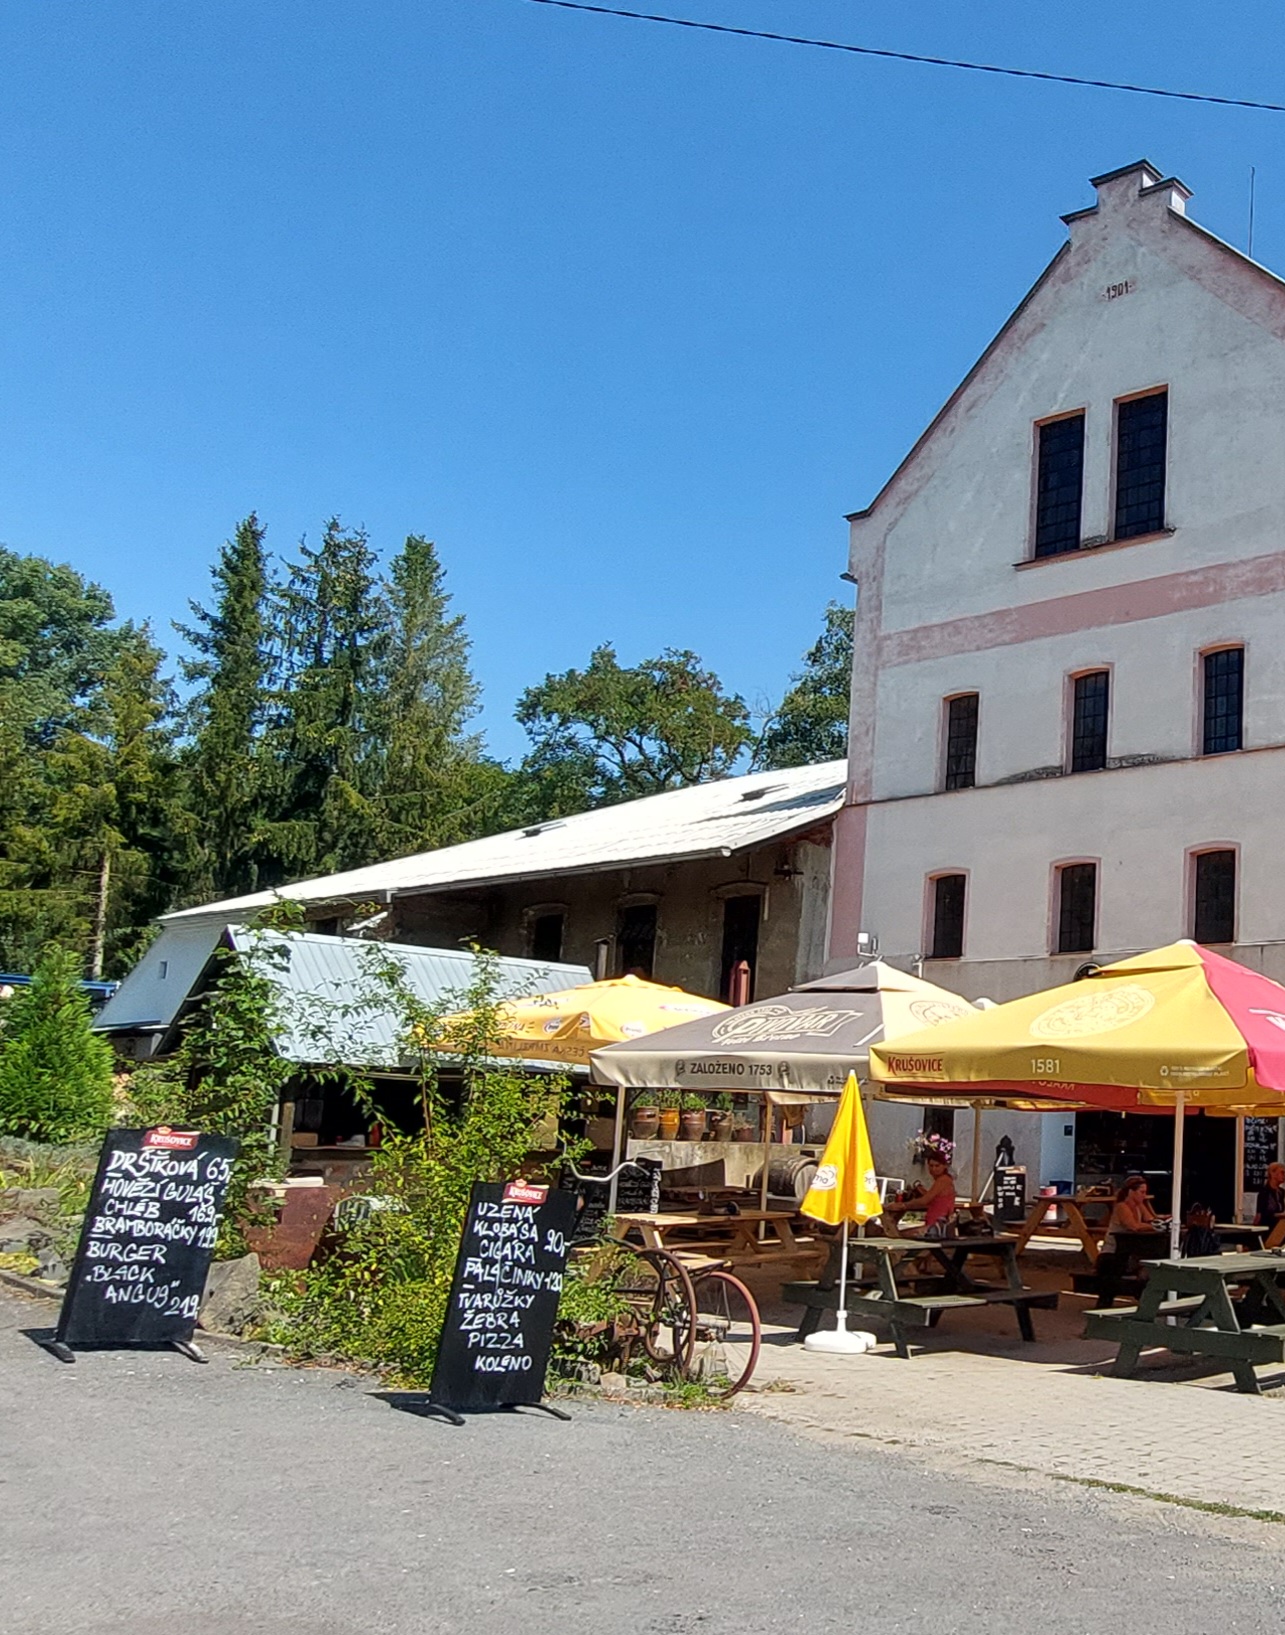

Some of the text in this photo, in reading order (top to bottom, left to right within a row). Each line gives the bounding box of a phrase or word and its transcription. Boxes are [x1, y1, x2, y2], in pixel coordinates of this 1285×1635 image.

[690, 1061, 772, 1076] ZALOŽENO 1753
[887, 1056, 943, 1073] KRUŠOVICE
[1030, 1059, 1060, 1074] 1581
[101, 1177, 169, 1198] HOVĚZÍ
[477, 1202, 541, 1223] UZENÁ
[92, 1216, 198, 1245] BRAMBORÁČKY
[473, 1220, 538, 1242] KLOBÁSA
[86, 1241, 167, 1264] BURGER
[480, 1239, 535, 1264] CIGÁRA
[464, 1261, 544, 1290] PALAČINKY
[458, 1288, 535, 1310] TVARŮŽKY
[460, 1309, 520, 1330] ŽEBRA
[468, 1332, 524, 1349] PIZZA
[475, 1355, 532, 1372] KOLENO
